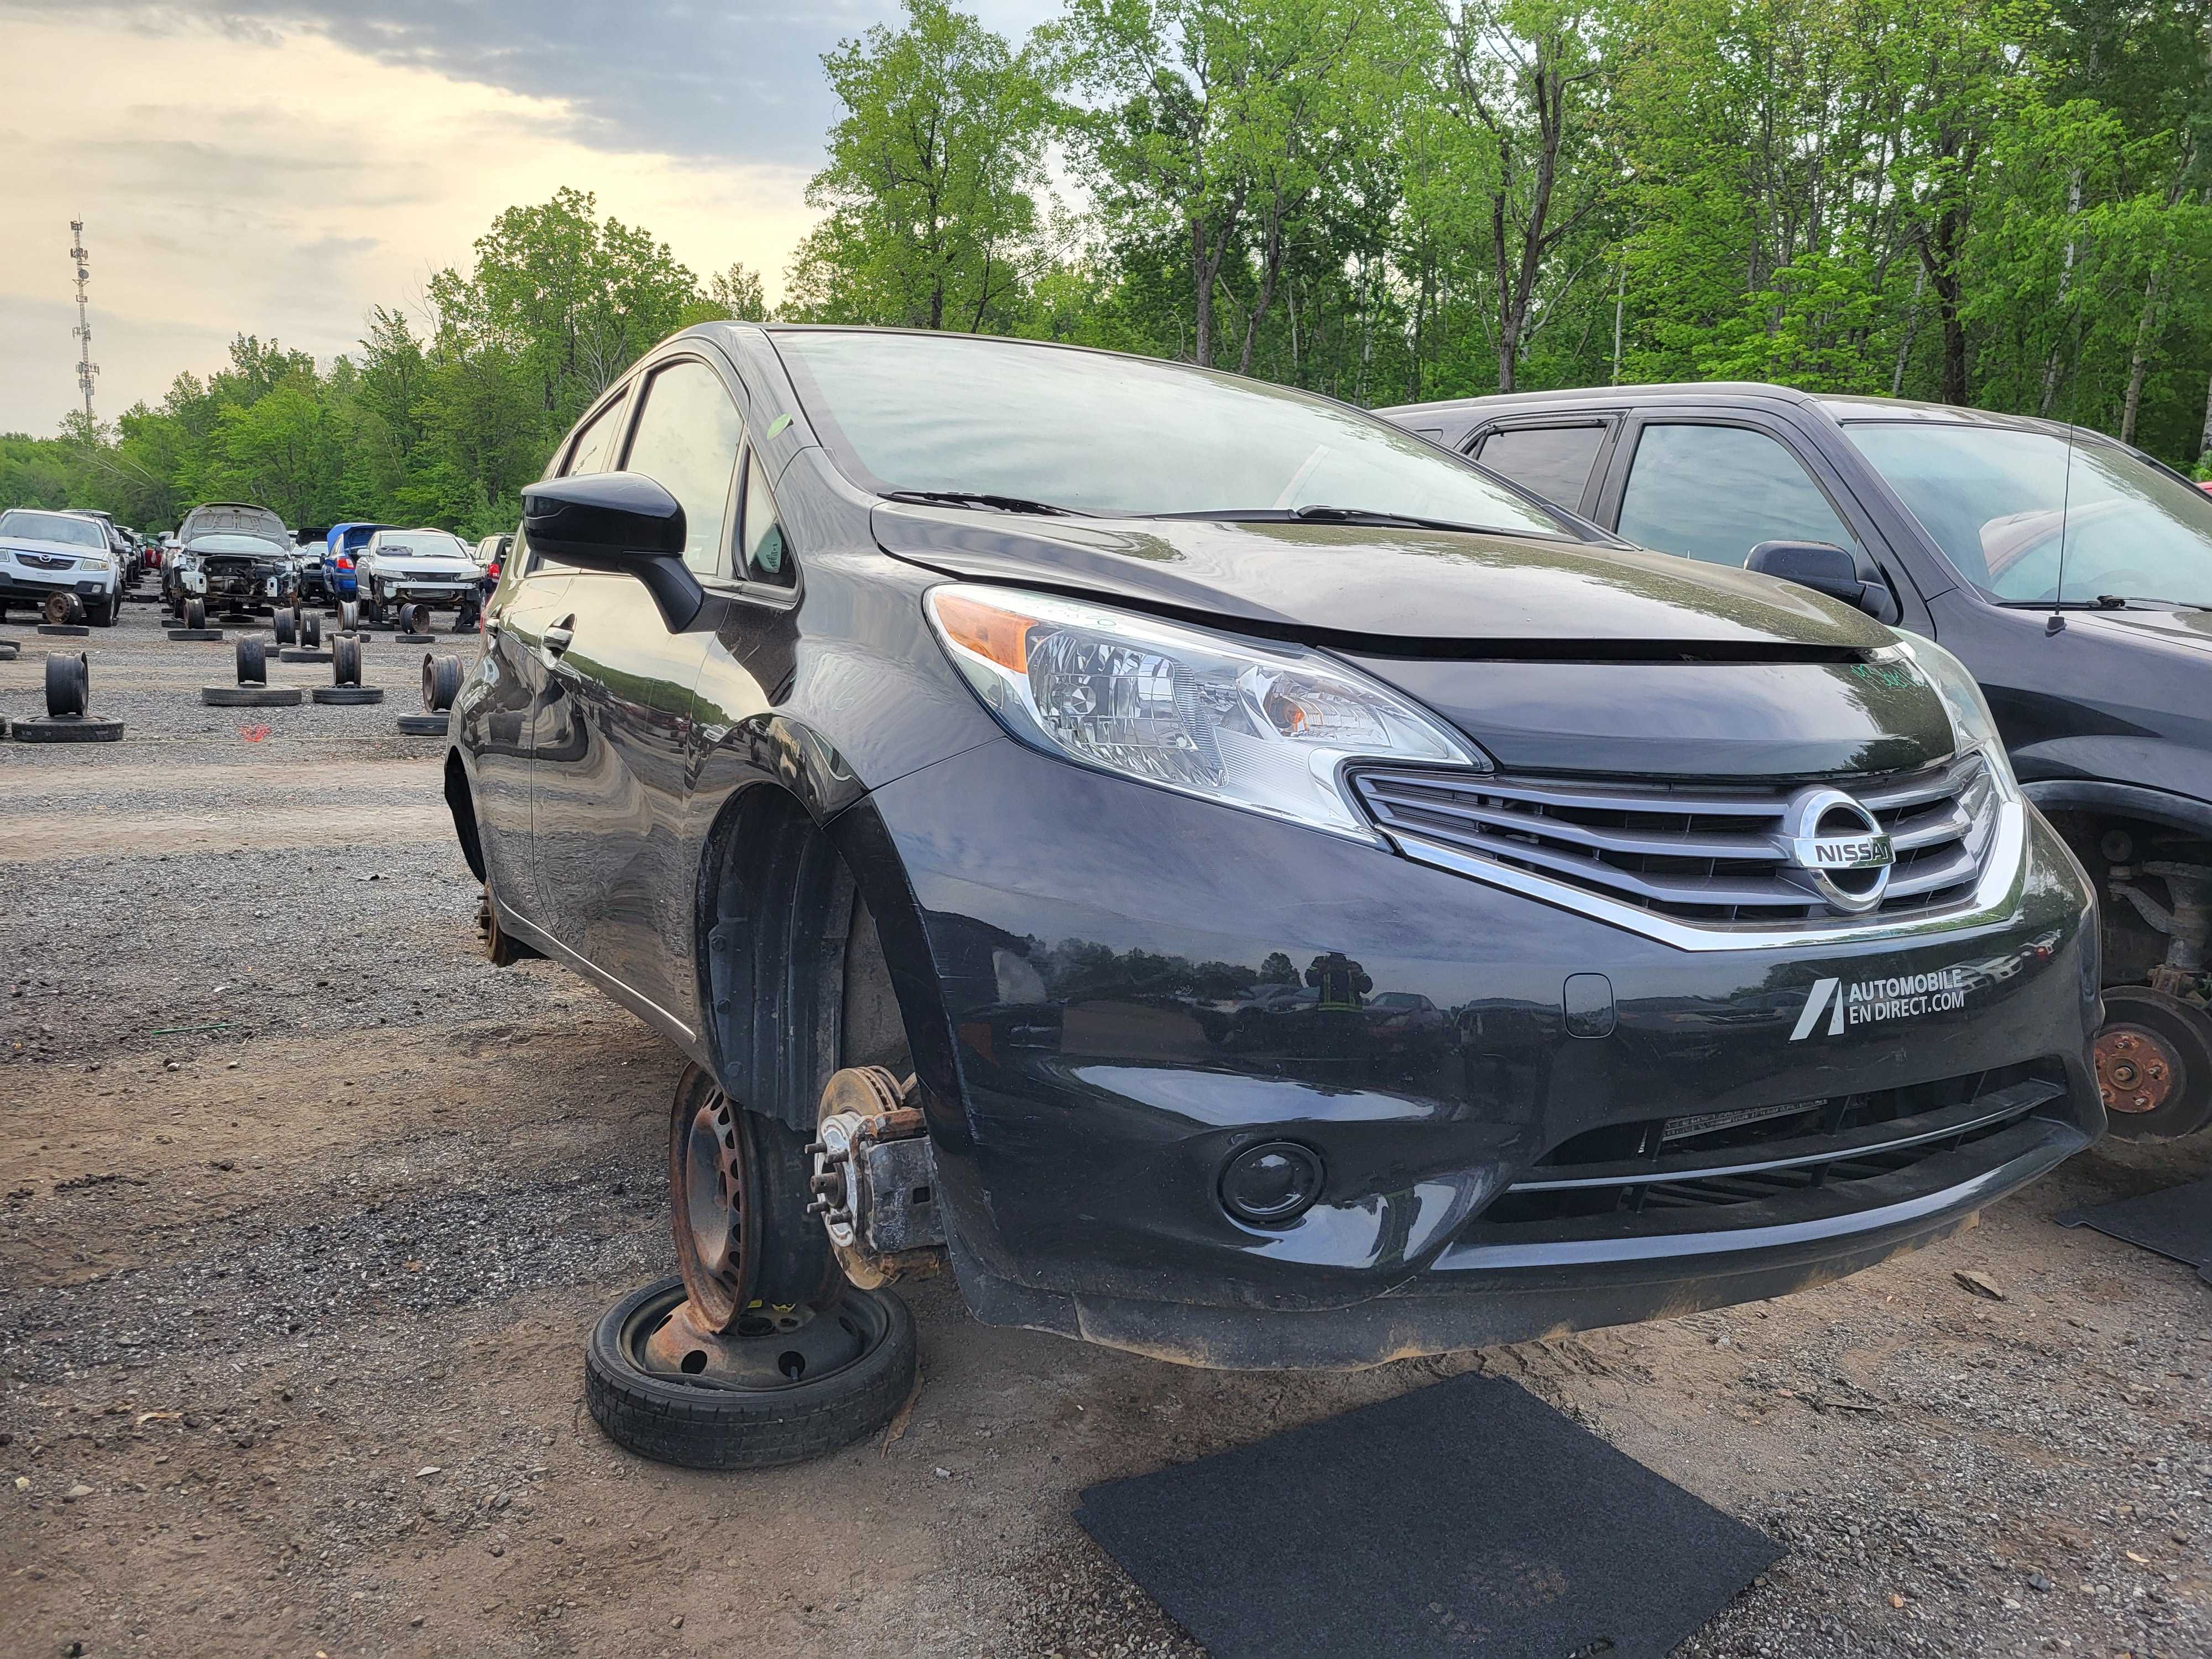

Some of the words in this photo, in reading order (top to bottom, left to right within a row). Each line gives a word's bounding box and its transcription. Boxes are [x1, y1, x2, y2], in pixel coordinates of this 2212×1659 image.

[1814, 841, 1893, 862] NISSAN
[1849, 969, 1964, 1003] AUTOMOBILE
[1849, 1005, 1871, 1024] EN
[1875, 991, 1964, 1021] DIRECT.COM
